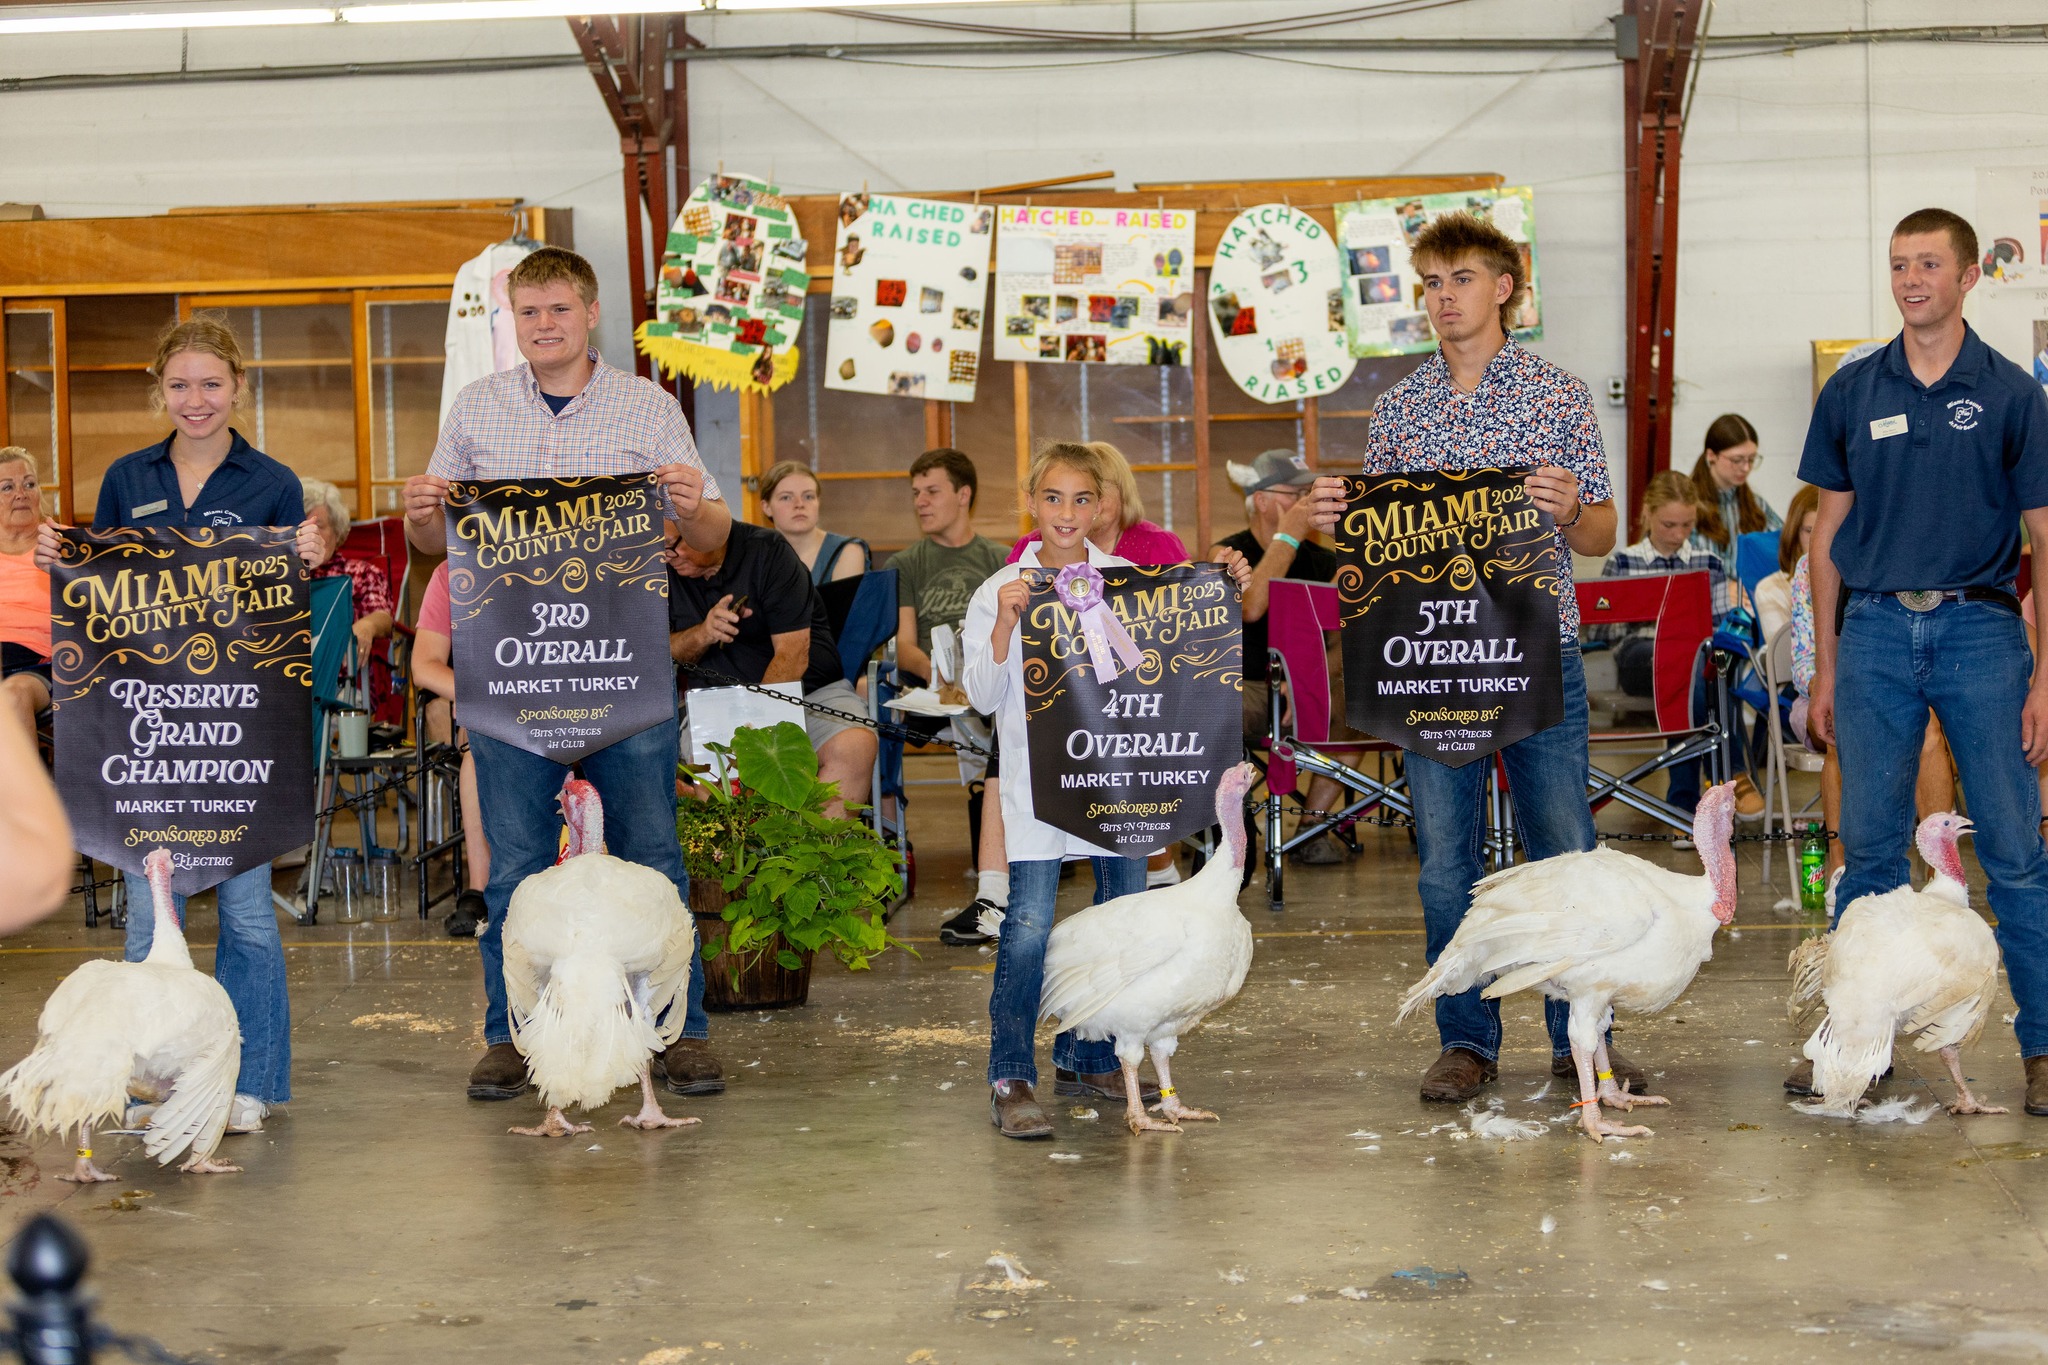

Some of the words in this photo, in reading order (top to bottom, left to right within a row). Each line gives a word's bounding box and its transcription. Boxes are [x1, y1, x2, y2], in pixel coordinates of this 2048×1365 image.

[1001, 208, 1095, 227] HATCHED
[1116, 211, 1187, 229] RAISED
[872, 221, 961, 247] RAISED
[1219, 208, 1321, 259] HATCHED
[1291, 260, 1309, 284] 3
[1244, 367, 1342, 399] RIASED
[1946, 398, 1964, 410] Miami
[1965, 399, 1984, 413] County
[203, 509, 223, 517] Miami
[224, 509, 243, 523] County
[456, 491, 604, 549] MIAMI
[604, 489, 647, 512] 2025
[1344, 486, 1491, 546] MIAMI
[476, 529, 581, 570] COUNTY
[582, 511, 652, 553] FAIR
[1364, 525, 1468, 566] COUNTY
[1470, 507, 1541, 551] FAIR
[62, 556, 240, 618] MIAMI
[239, 554, 289, 581] 2025
[85, 600, 210, 644] COUNTY
[212, 579, 296, 628] FAIR
[527, 602, 591, 637] 3RD
[1030, 582, 1183, 640] MAMI
[1182, 580, 1226, 604] 2025
[1415, 599, 1479, 636] 5TH
[1050, 619, 1157, 660] COTY
[1159, 602, 1229, 645] FAIR
[494, 637, 633, 668] OVERALL
[1383, 635, 1524, 668] OVERALL
[109, 678, 260, 712] RESERVE
[488, 678, 563, 695] MARKET
[568, 676, 640, 693] TURKEY
[1377, 678, 1452, 695] MARKET
[1457, 676, 1530, 693] TURKEY
[516, 705, 589, 725] SPONSORED
[590, 704, 613, 720] BY:
[1101, 688, 1164, 719] 4TH
[1406, 706, 1479, 726] SPONSORED
[1480, 705, 1504, 722] BY:
[129, 708, 243, 757] GRAND
[530, 728, 553, 738] BITS
[567, 727, 602, 737] PIECES
[547, 740, 559, 749] 4H
[561, 739, 585, 749] CLUB
[1066, 729, 1206, 761] OVERALL
[1419, 730, 1444, 740] BITS
[1457, 729, 1492, 739] PIECES
[1436, 741, 1449, 751] 4H
[1451, 740, 1476, 751] CLUB
[101, 754, 274, 786] CHAMPION
[1060, 772, 1134, 789] MARKET
[1138, 770, 1211, 786] TURKEY
[115, 800, 186, 814] MARKET
[191, 799, 258, 813] TURKEY
[1086, 799, 1158, 819] SPONSORED
[1160, 798, 1183, 815] BY:
[124, 825, 217, 847] SPONSORED
[218, 825, 248, 846] BY:
[1099, 822, 1122, 832] BITS
[1136, 821, 1171, 831] PIECES
[1115, 834, 1128, 844] 4H
[1129, 833, 1154, 844] CLUB
[172, 852, 234, 871] ELECTRIC
